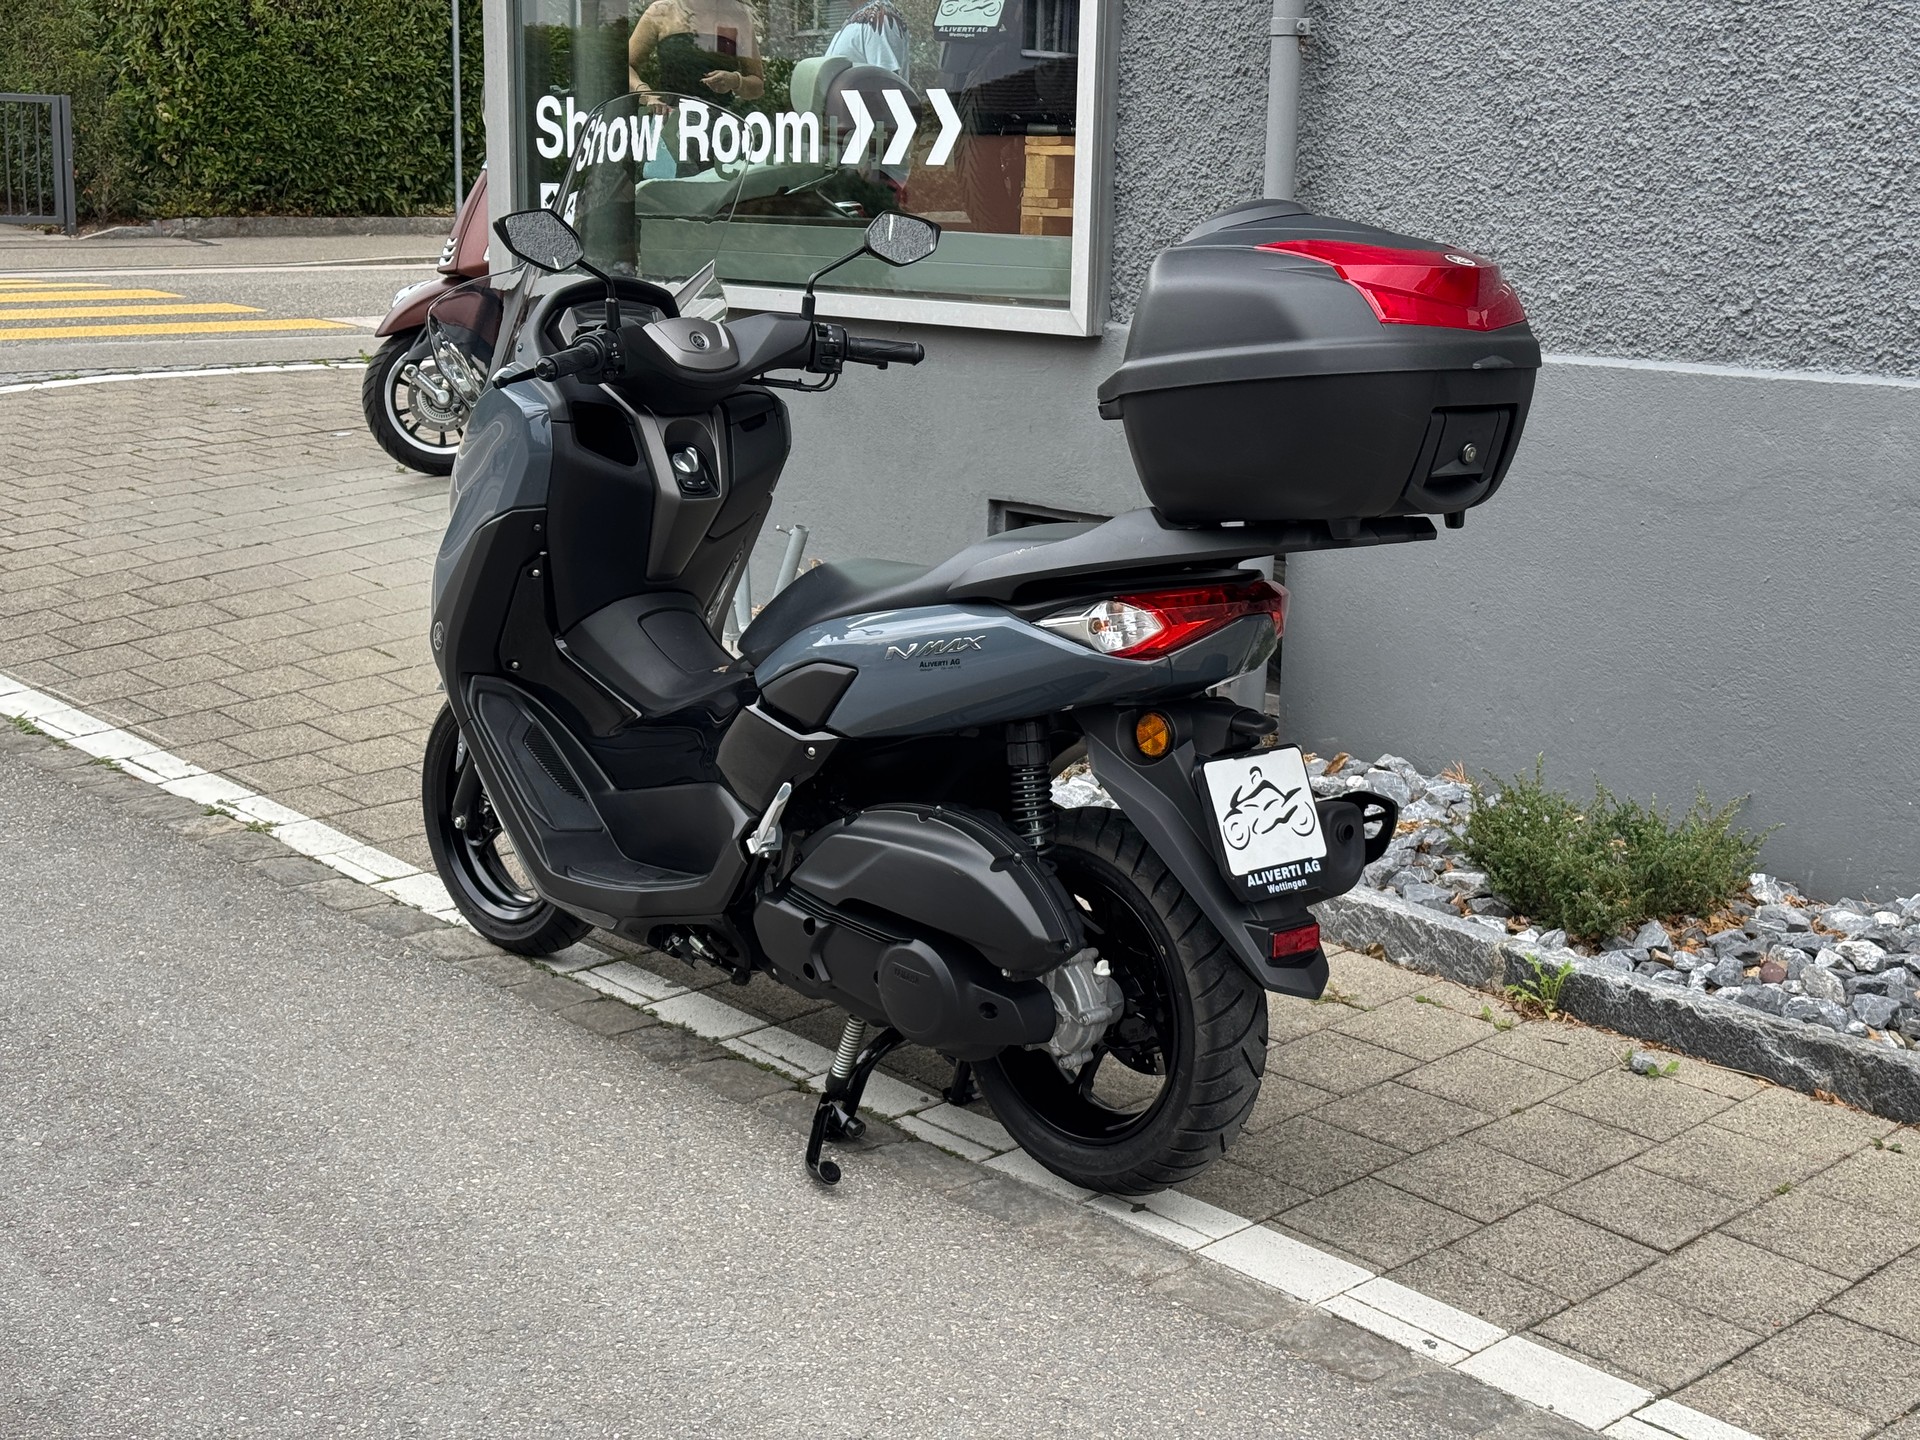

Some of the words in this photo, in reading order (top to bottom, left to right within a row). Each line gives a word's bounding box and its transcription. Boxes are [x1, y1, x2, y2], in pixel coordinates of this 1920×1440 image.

[678, 98, 820, 165] Room
[884, 635, 986, 661] NMAX
[919, 660, 948, 668] ALIVERTI
[949, 658, 961, 666] AG
[1247, 863, 1302, 887] ALIVERTI
[1304, 860, 1321, 874] AG
[1267, 878, 1308, 894] Wettingen
